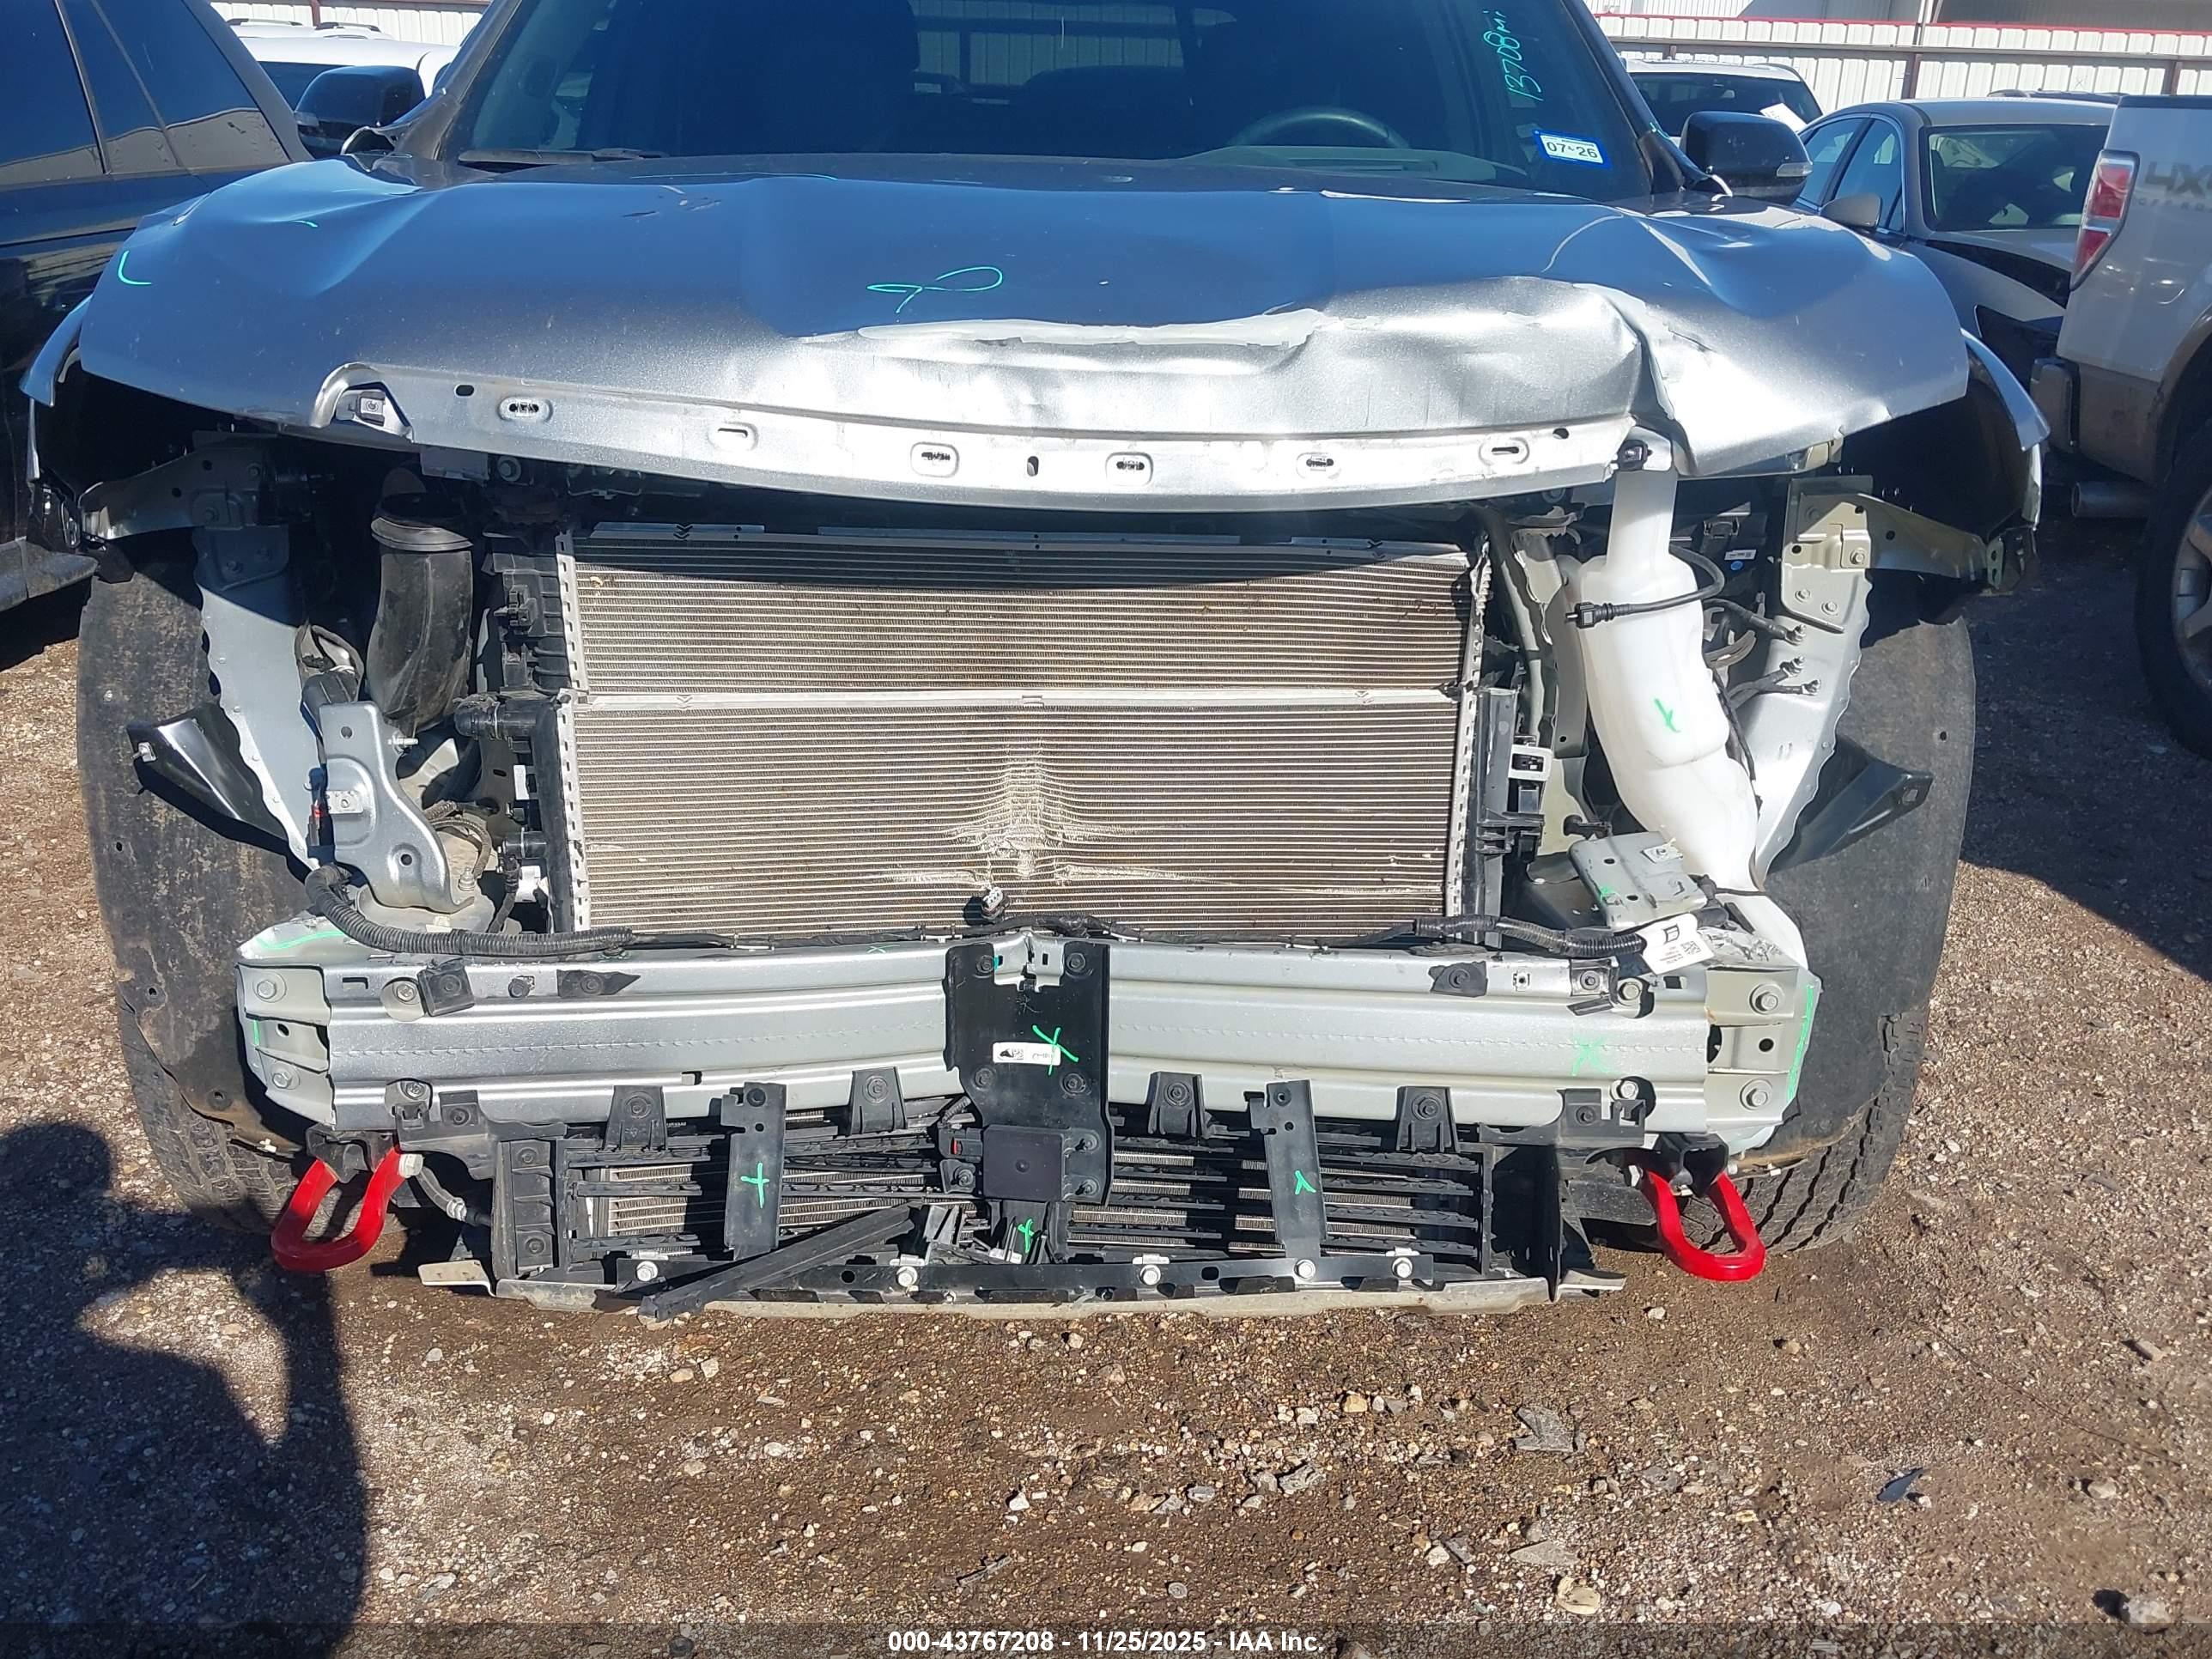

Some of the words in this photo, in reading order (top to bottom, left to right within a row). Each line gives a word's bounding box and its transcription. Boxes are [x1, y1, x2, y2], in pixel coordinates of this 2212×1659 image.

[1547, 142, 1566, 153] 07
[1576, 146, 1598, 158] 26
[2144, 161, 2212, 198] 4X
